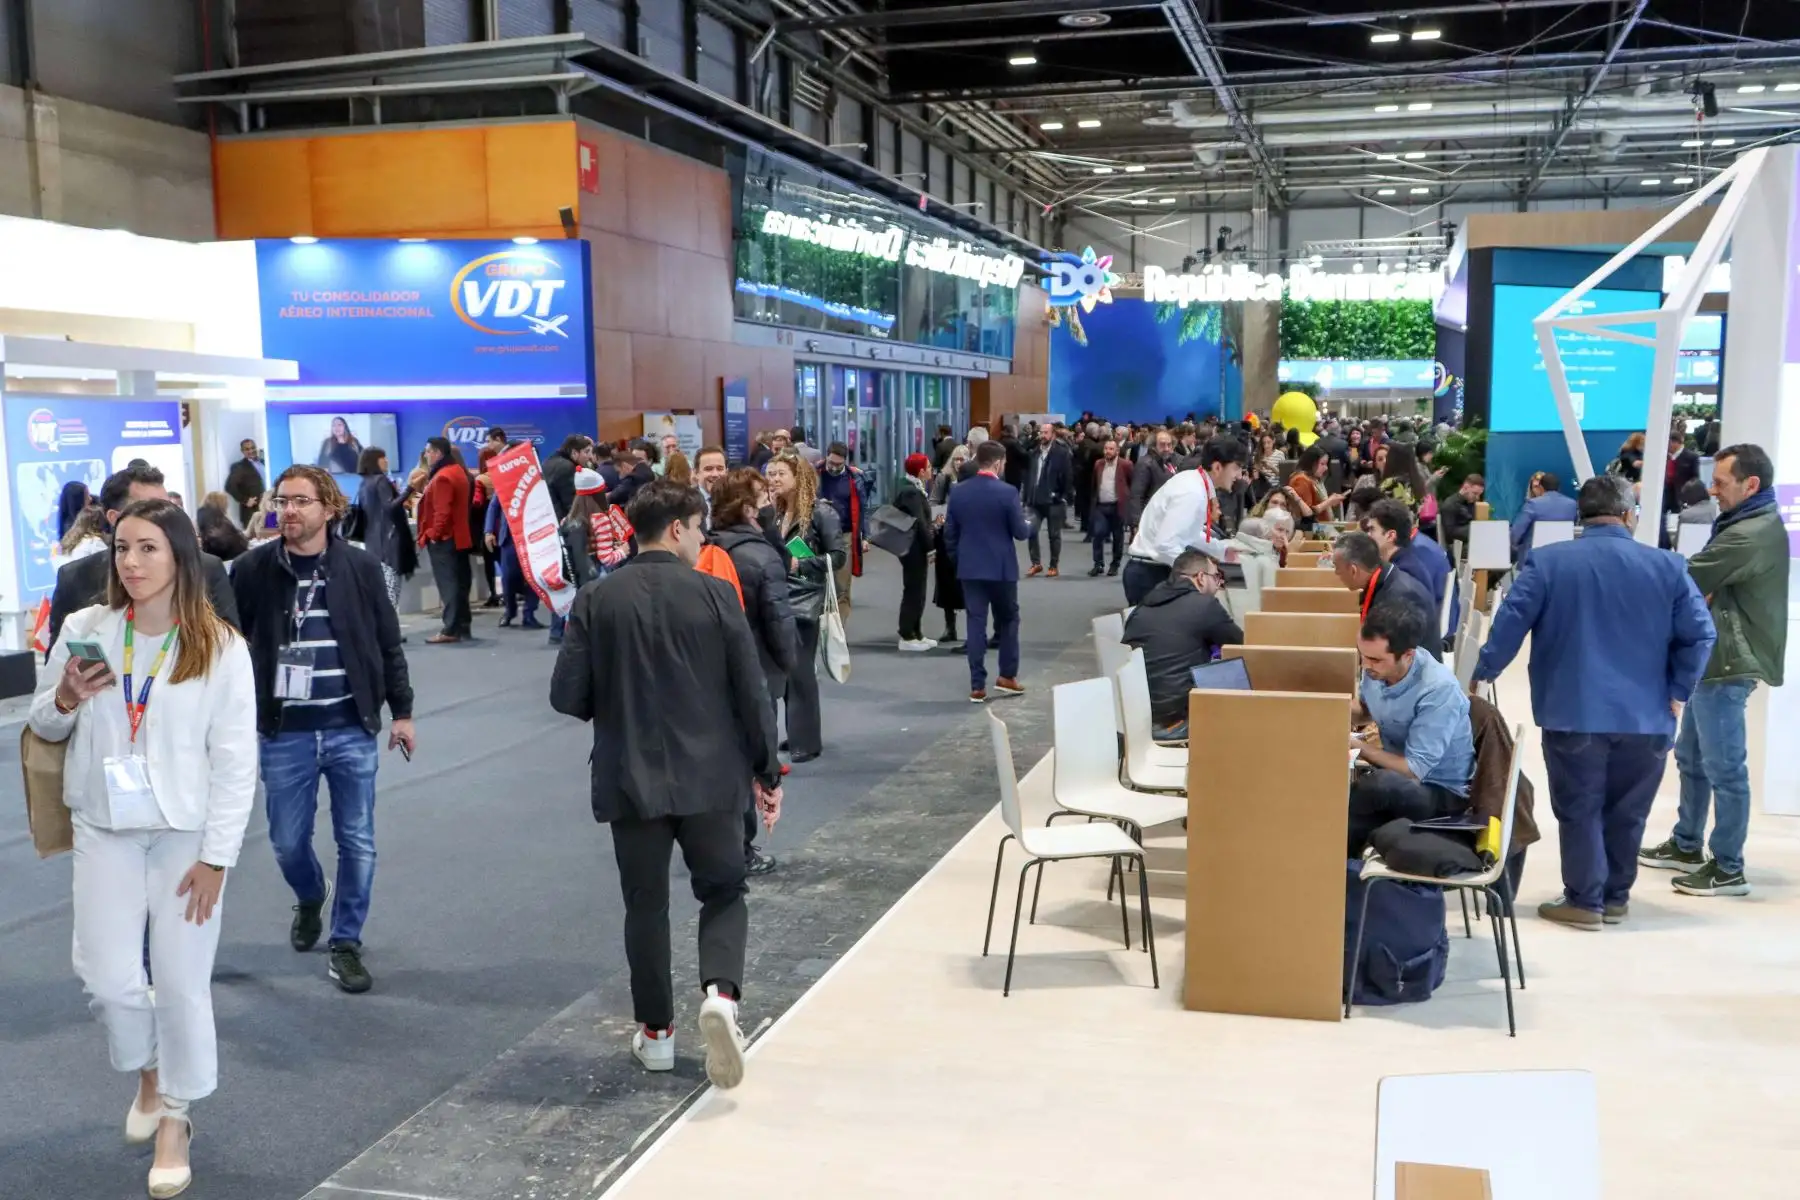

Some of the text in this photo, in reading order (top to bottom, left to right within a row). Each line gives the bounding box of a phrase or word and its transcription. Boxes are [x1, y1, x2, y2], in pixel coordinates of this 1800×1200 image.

[485, 264, 546, 277] GRUPO
[1144, 263, 1283, 309] República
[291, 290, 420, 302] TU CONSOLIDADOR
[463, 279, 565, 318] VDT
[279, 305, 435, 318] AÉREO INTERNACIONAL
[447, 426, 490, 443] VDT
[508, 464, 538, 518] SORTEO
